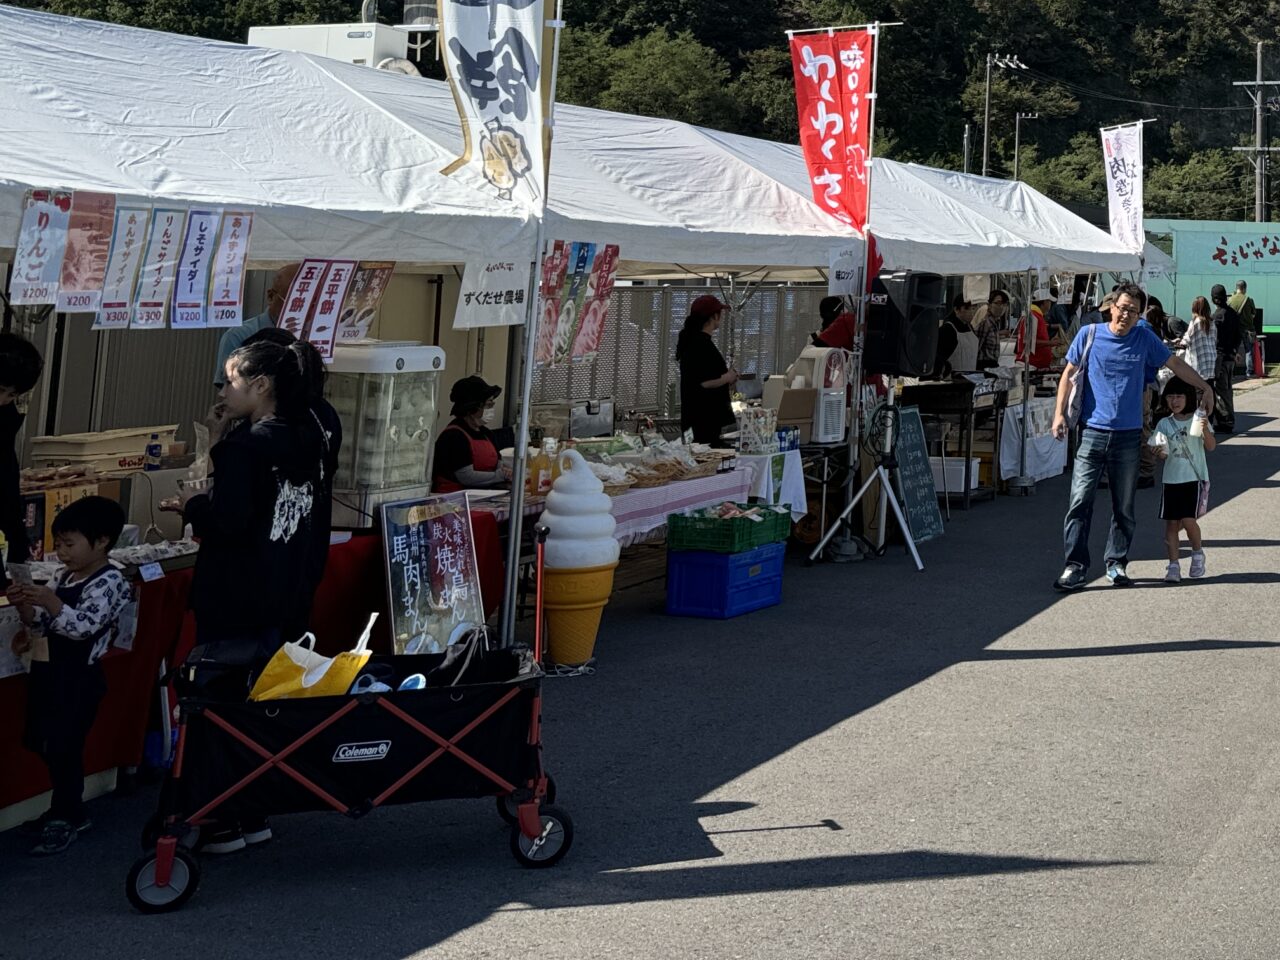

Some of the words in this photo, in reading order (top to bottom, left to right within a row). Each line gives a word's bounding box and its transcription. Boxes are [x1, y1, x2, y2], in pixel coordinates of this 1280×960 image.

[26, 211, 50, 282] りんご
[114, 213, 137, 300] あんずサイダー
[151, 215, 174, 300] りんごサイダー
[187, 221, 208, 294] しそサイダー
[221, 217, 242, 300] あんずジュース
[573, 246, 588, 289] バニラ
[22, 287, 48, 298] ¥200
[67, 296, 91, 306] ¥200
[289, 266, 318, 312] 五平餅
[320, 268, 346, 315] 五平餅
[463, 289, 525, 306] ずくだせ農場
[106, 311, 128, 321] ¥300
[139, 311, 161, 321] ¥300
[179, 311, 201, 321] ¥200
[409, 526, 420, 557] 信州
[432, 523, 453, 544] 炭火
[452, 518, 466, 570] 美味だれ
[391, 534, 428, 635] 馬肉まん
[434, 545, 470, 625] 焼鳥まん
[339, 746, 377, 758] Coleman
